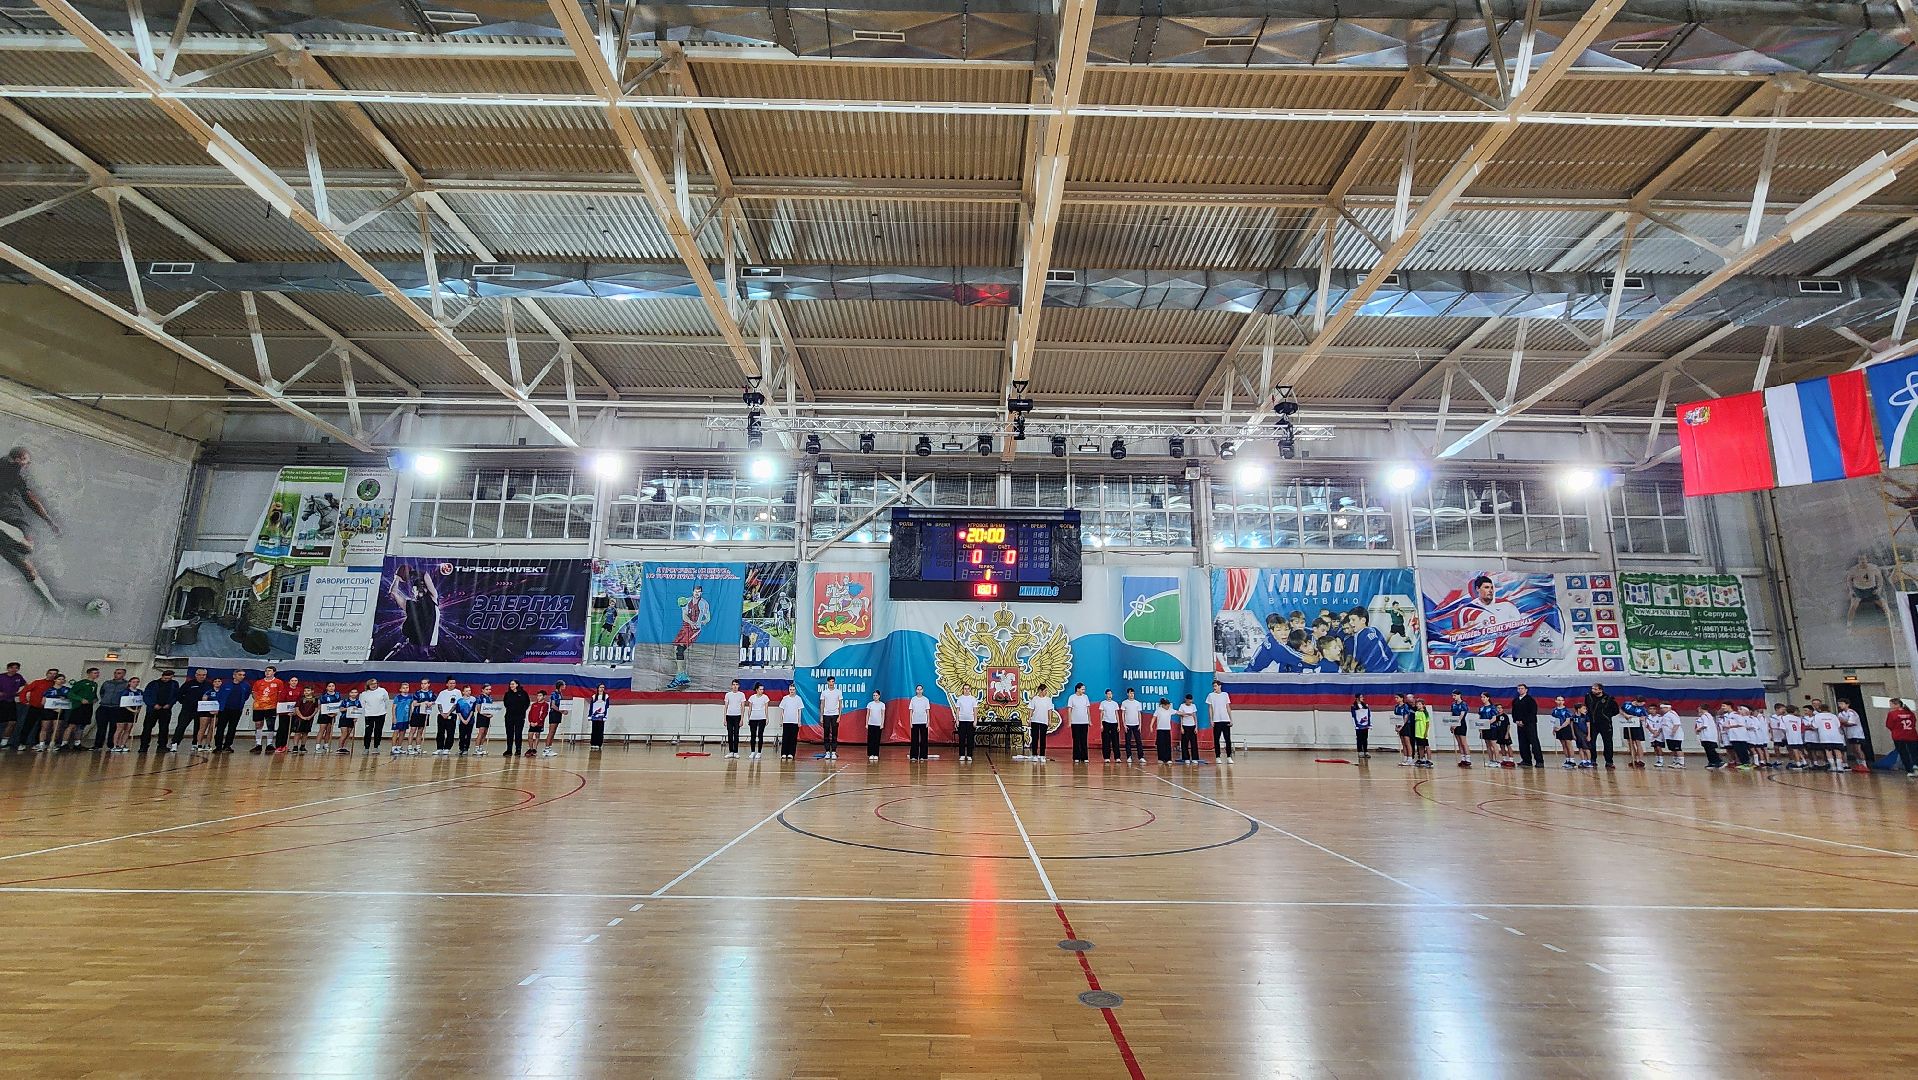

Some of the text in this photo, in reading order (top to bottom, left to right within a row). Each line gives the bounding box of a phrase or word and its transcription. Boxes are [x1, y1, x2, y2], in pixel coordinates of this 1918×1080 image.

[966, 528, 1006, 543] 20:00
[971, 549, 983, 564] 0
[1005, 550, 1016, 565] 0
[1018, 585, 1060, 597] ИМПУЛЬС
[1268, 573, 1361, 597] ГАНДБОЛ
[472, 594, 576, 612] ЭНЕРГИЯ
[1268, 597, 1360, 605] В ПРОТВИНО
[466, 612, 571, 630] СПОРТА
[1703, 610, 1738, 619] Серпухов
[593, 646, 788, 662] СПОНС ОТВИНО
[811, 668, 872, 678] АДМИНИСТРАЦИЯ
[1123, 670, 1185, 680] АДМИНИСТРАЦИЯ
[817, 682, 866, 693] МОКОВСКОЙ
[1141, 686, 1169, 695] ГОРОДА
